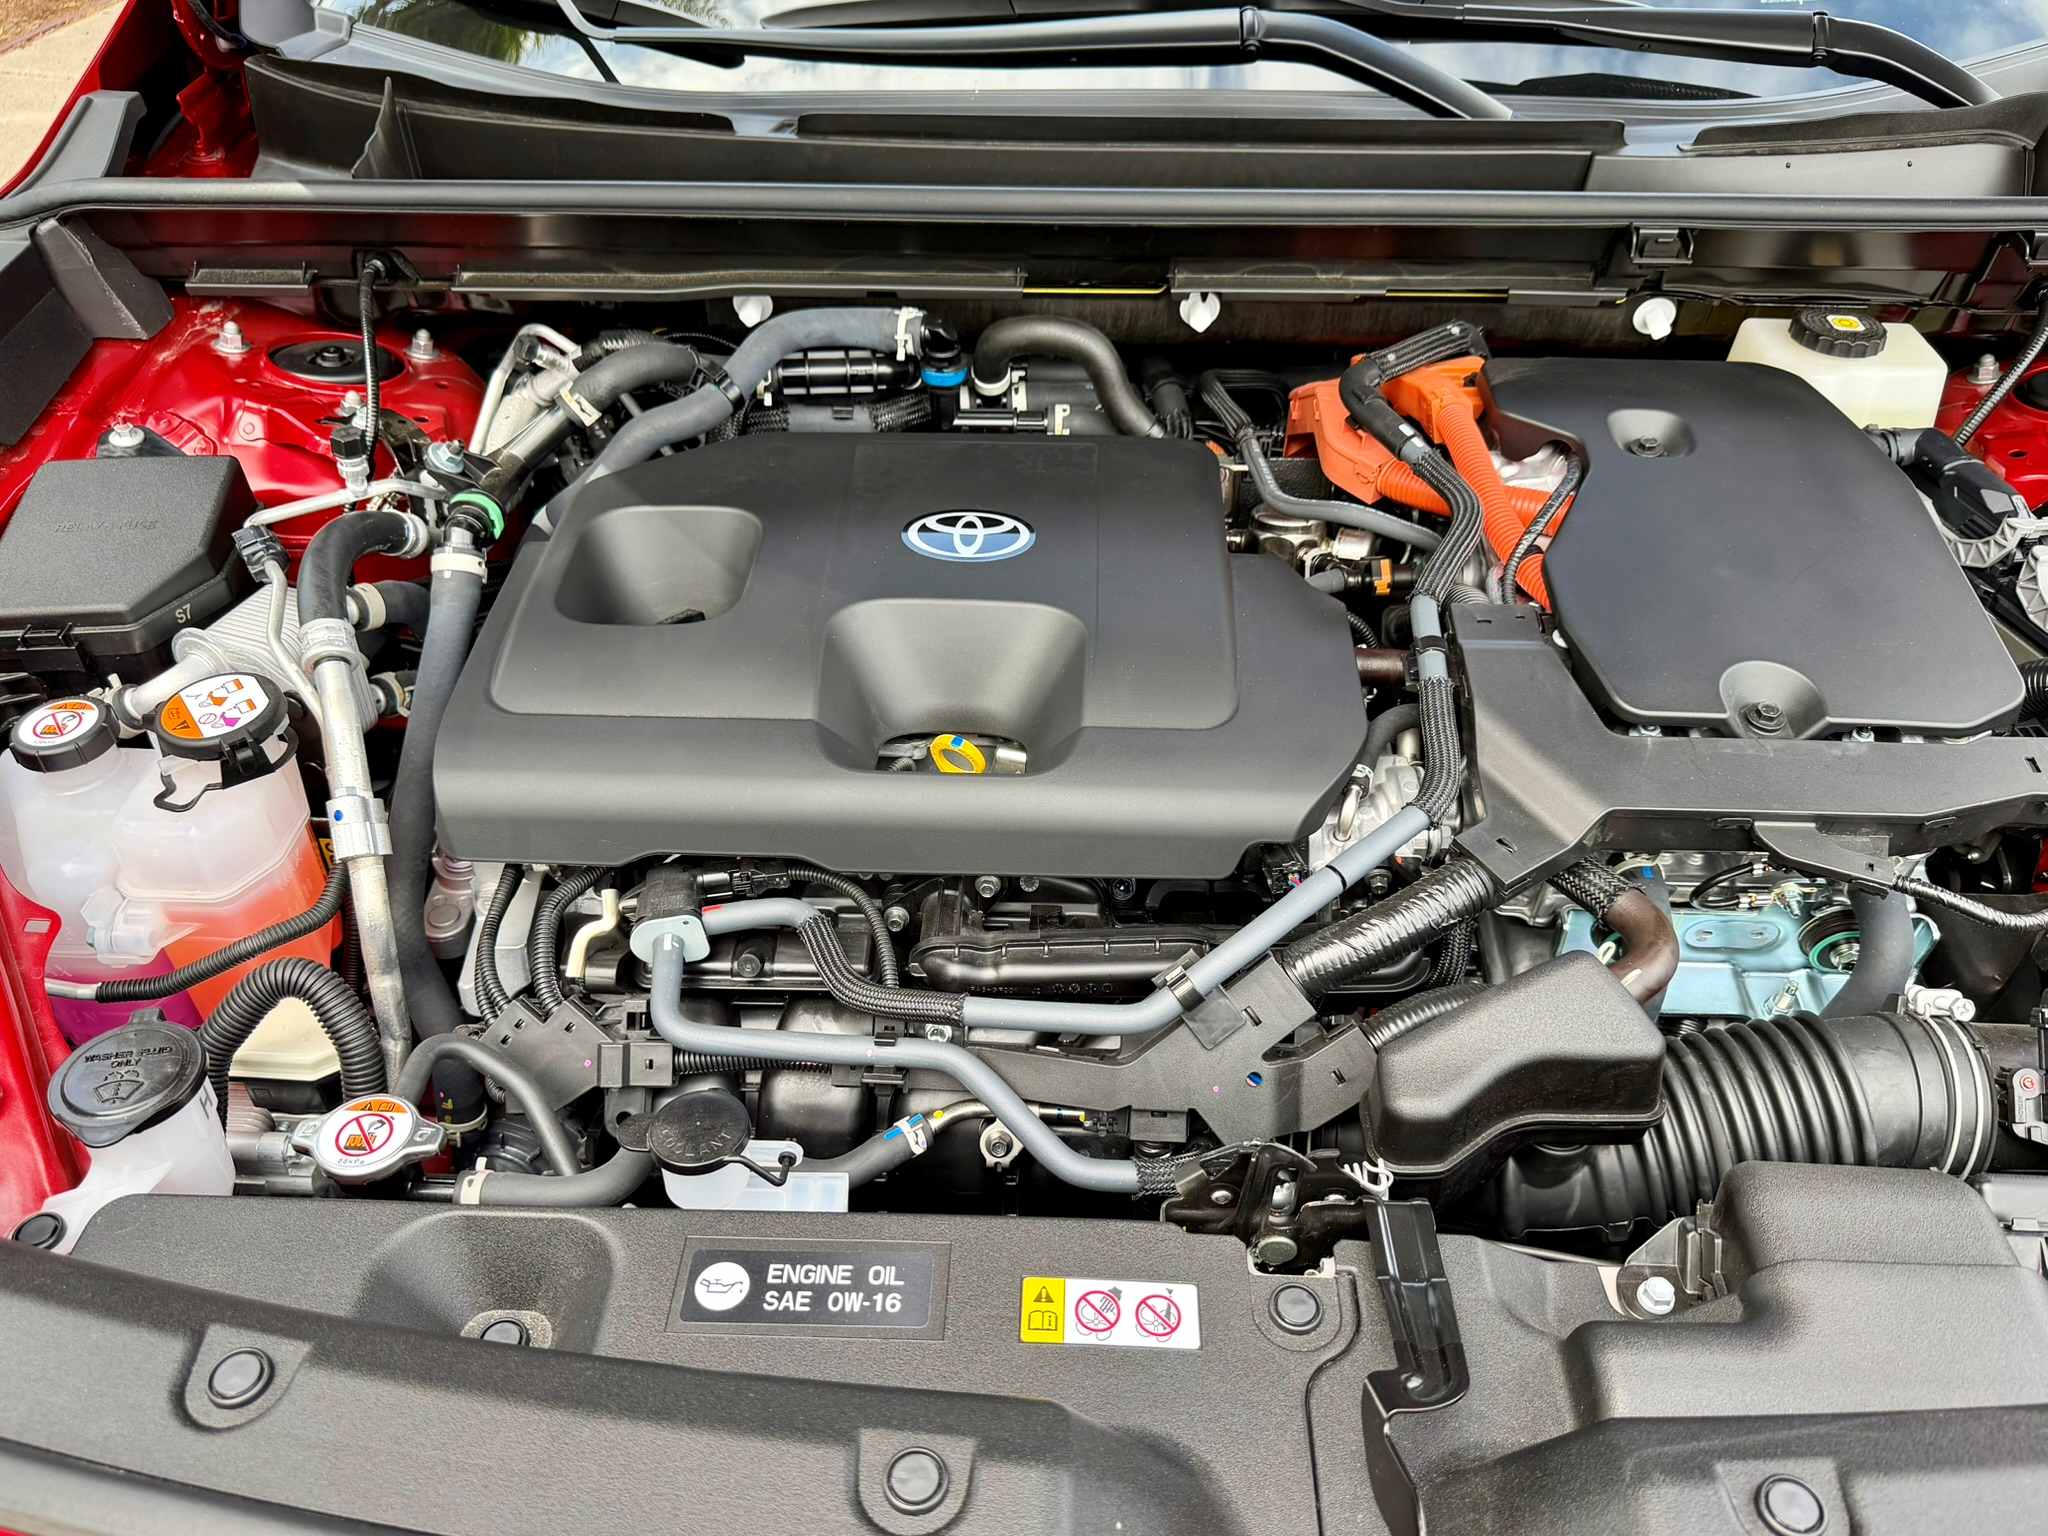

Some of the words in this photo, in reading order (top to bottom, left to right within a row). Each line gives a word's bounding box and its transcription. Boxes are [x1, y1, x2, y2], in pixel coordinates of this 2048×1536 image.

[175, 603, 192, 624] S7
[84, 1050, 134, 1063] WASHER
[111, 1058, 142, 1069] ONLY
[767, 1263, 854, 1286] ENGINE
[868, 1265, 905, 1286] OIL
[762, 1290, 813, 1312] SAE
[827, 1291, 902, 1313] 0W-16
